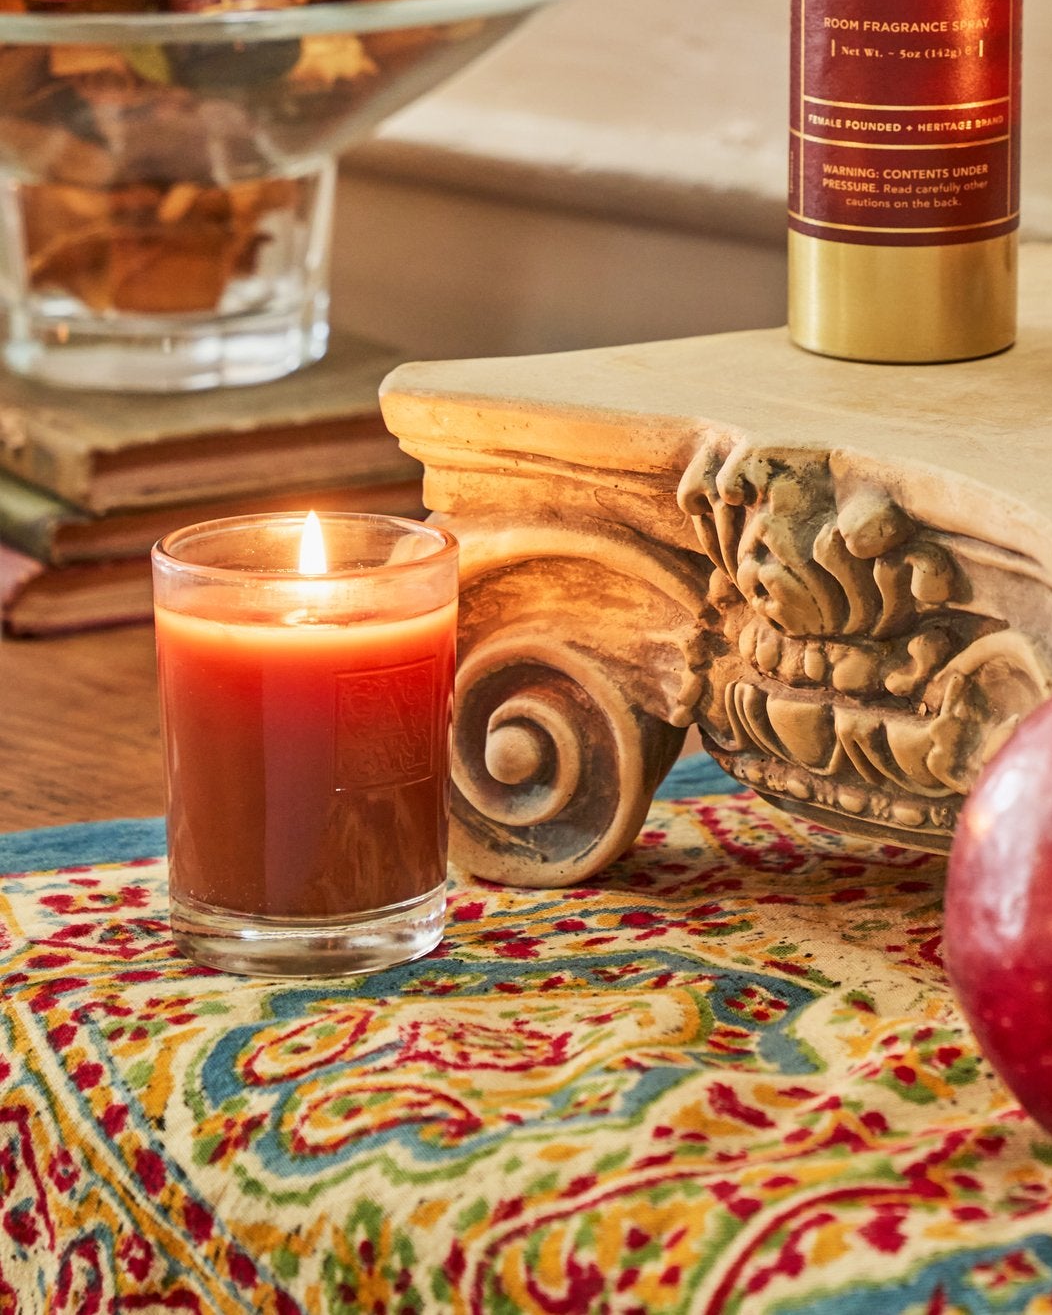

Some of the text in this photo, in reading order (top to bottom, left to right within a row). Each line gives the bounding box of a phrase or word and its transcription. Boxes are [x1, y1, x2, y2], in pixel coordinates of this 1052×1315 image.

[824, 17, 989, 33] ROOM FRAGRANCE SPRAY
[841, 46, 860, 57] Net
[864, 48, 883, 58] Wt.
[900, 49, 920, 59] 5oz
[808, 114, 1004, 132] FEMALE FOUNDED HERITAGE BRAND
[822, 163, 988, 179] WARNING: CONTENTS UNDER
[822, 178, 988, 194] PRESSURE. Read carefully other
[845, 197, 890, 208] cautions
[912, 198, 930, 208] the
[934, 196, 962, 208] back.
